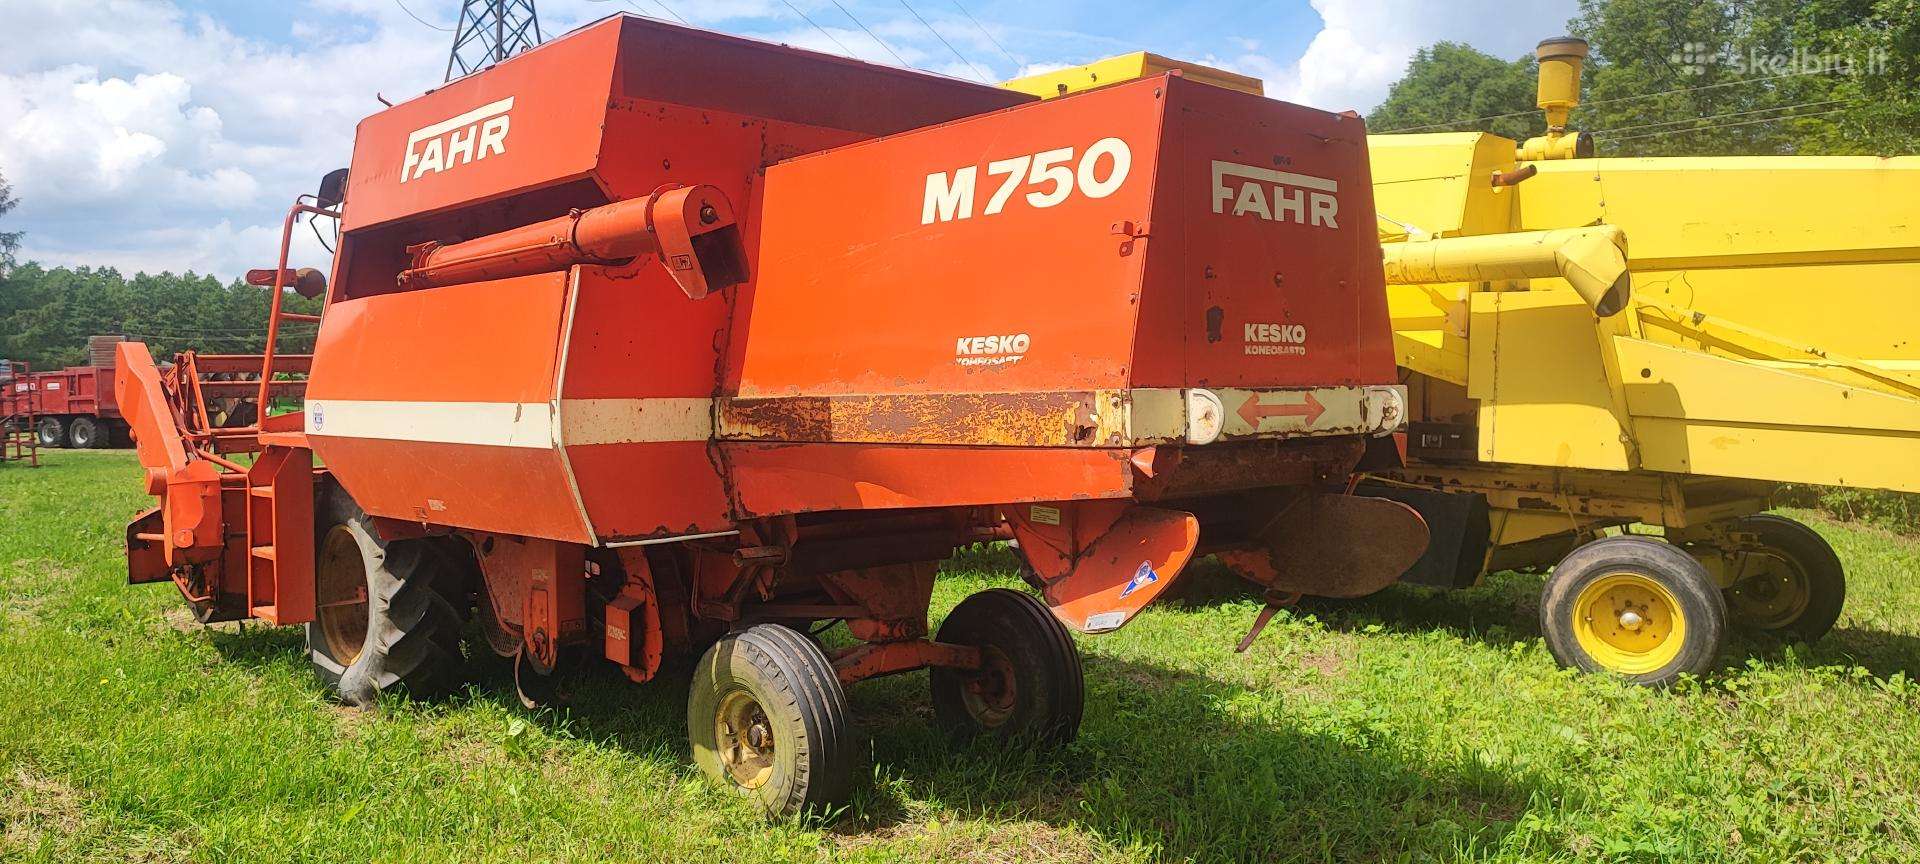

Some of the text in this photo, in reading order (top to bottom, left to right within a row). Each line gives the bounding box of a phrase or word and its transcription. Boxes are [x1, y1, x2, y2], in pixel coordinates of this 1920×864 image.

[400, 95, 515, 184] FAHR
[921, 137, 1132, 225] M 750
[1211, 160, 1339, 229] FAHR
[956, 333, 1031, 355] KESKO
[1244, 323, 1306, 343] KESKO
